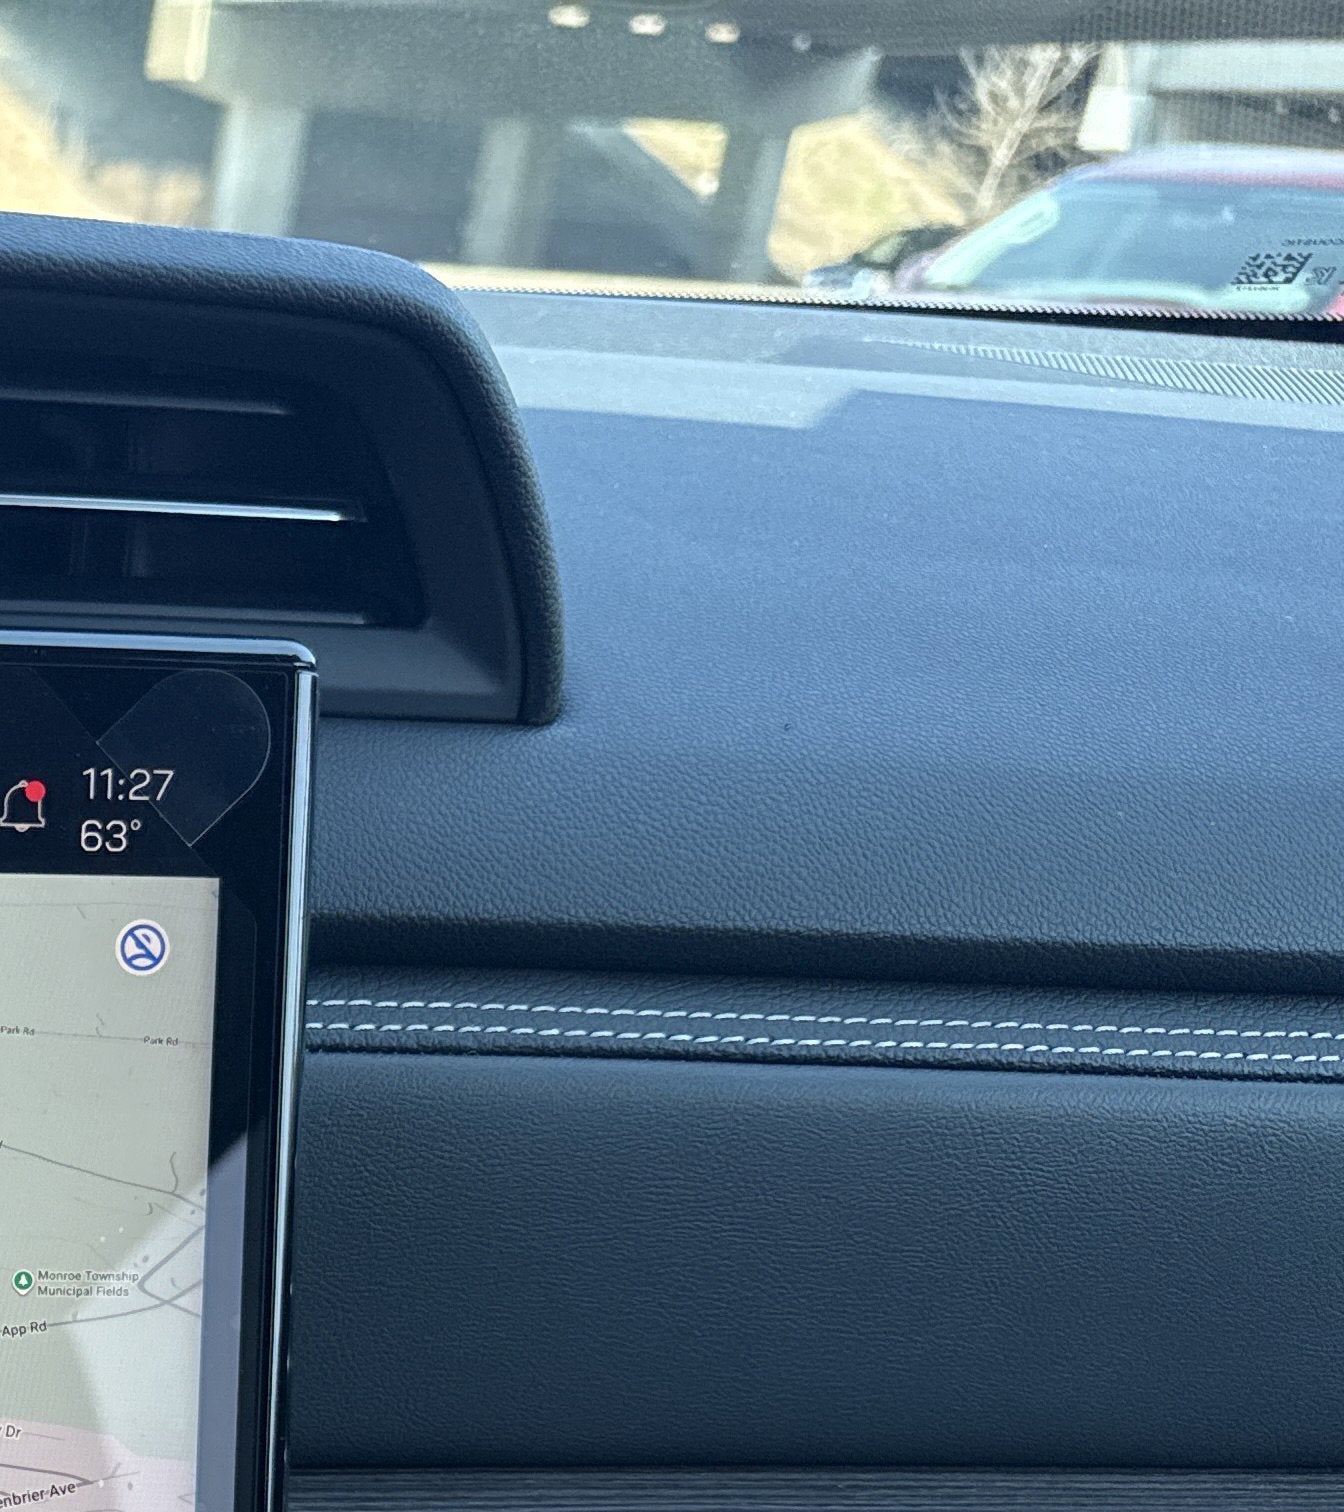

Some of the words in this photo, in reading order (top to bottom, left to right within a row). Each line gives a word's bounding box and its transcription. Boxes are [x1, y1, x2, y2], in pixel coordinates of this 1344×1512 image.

[82, 768, 174, 801] 11:27
[80, 819, 142, 852] 63°
[0, 1026, 20, 1036] Park
[22, 1027, 35, 1036] Rd
[143, 1036, 163, 1046] Park
[165, 1037, 178, 1047] Rd
[37, 1270, 81, 1281] Monroe
[85, 1270, 139, 1283] Township
[37, 1285, 93, 1299] Municipal
[96, 1286, 129, 1297] Fields
[2, 1324, 27, 1338] App
[30, 1320, 47, 1333] Rd
[6, 1426, 21, 1439] Dr
[49, 1482, 77, 1498] Ave
